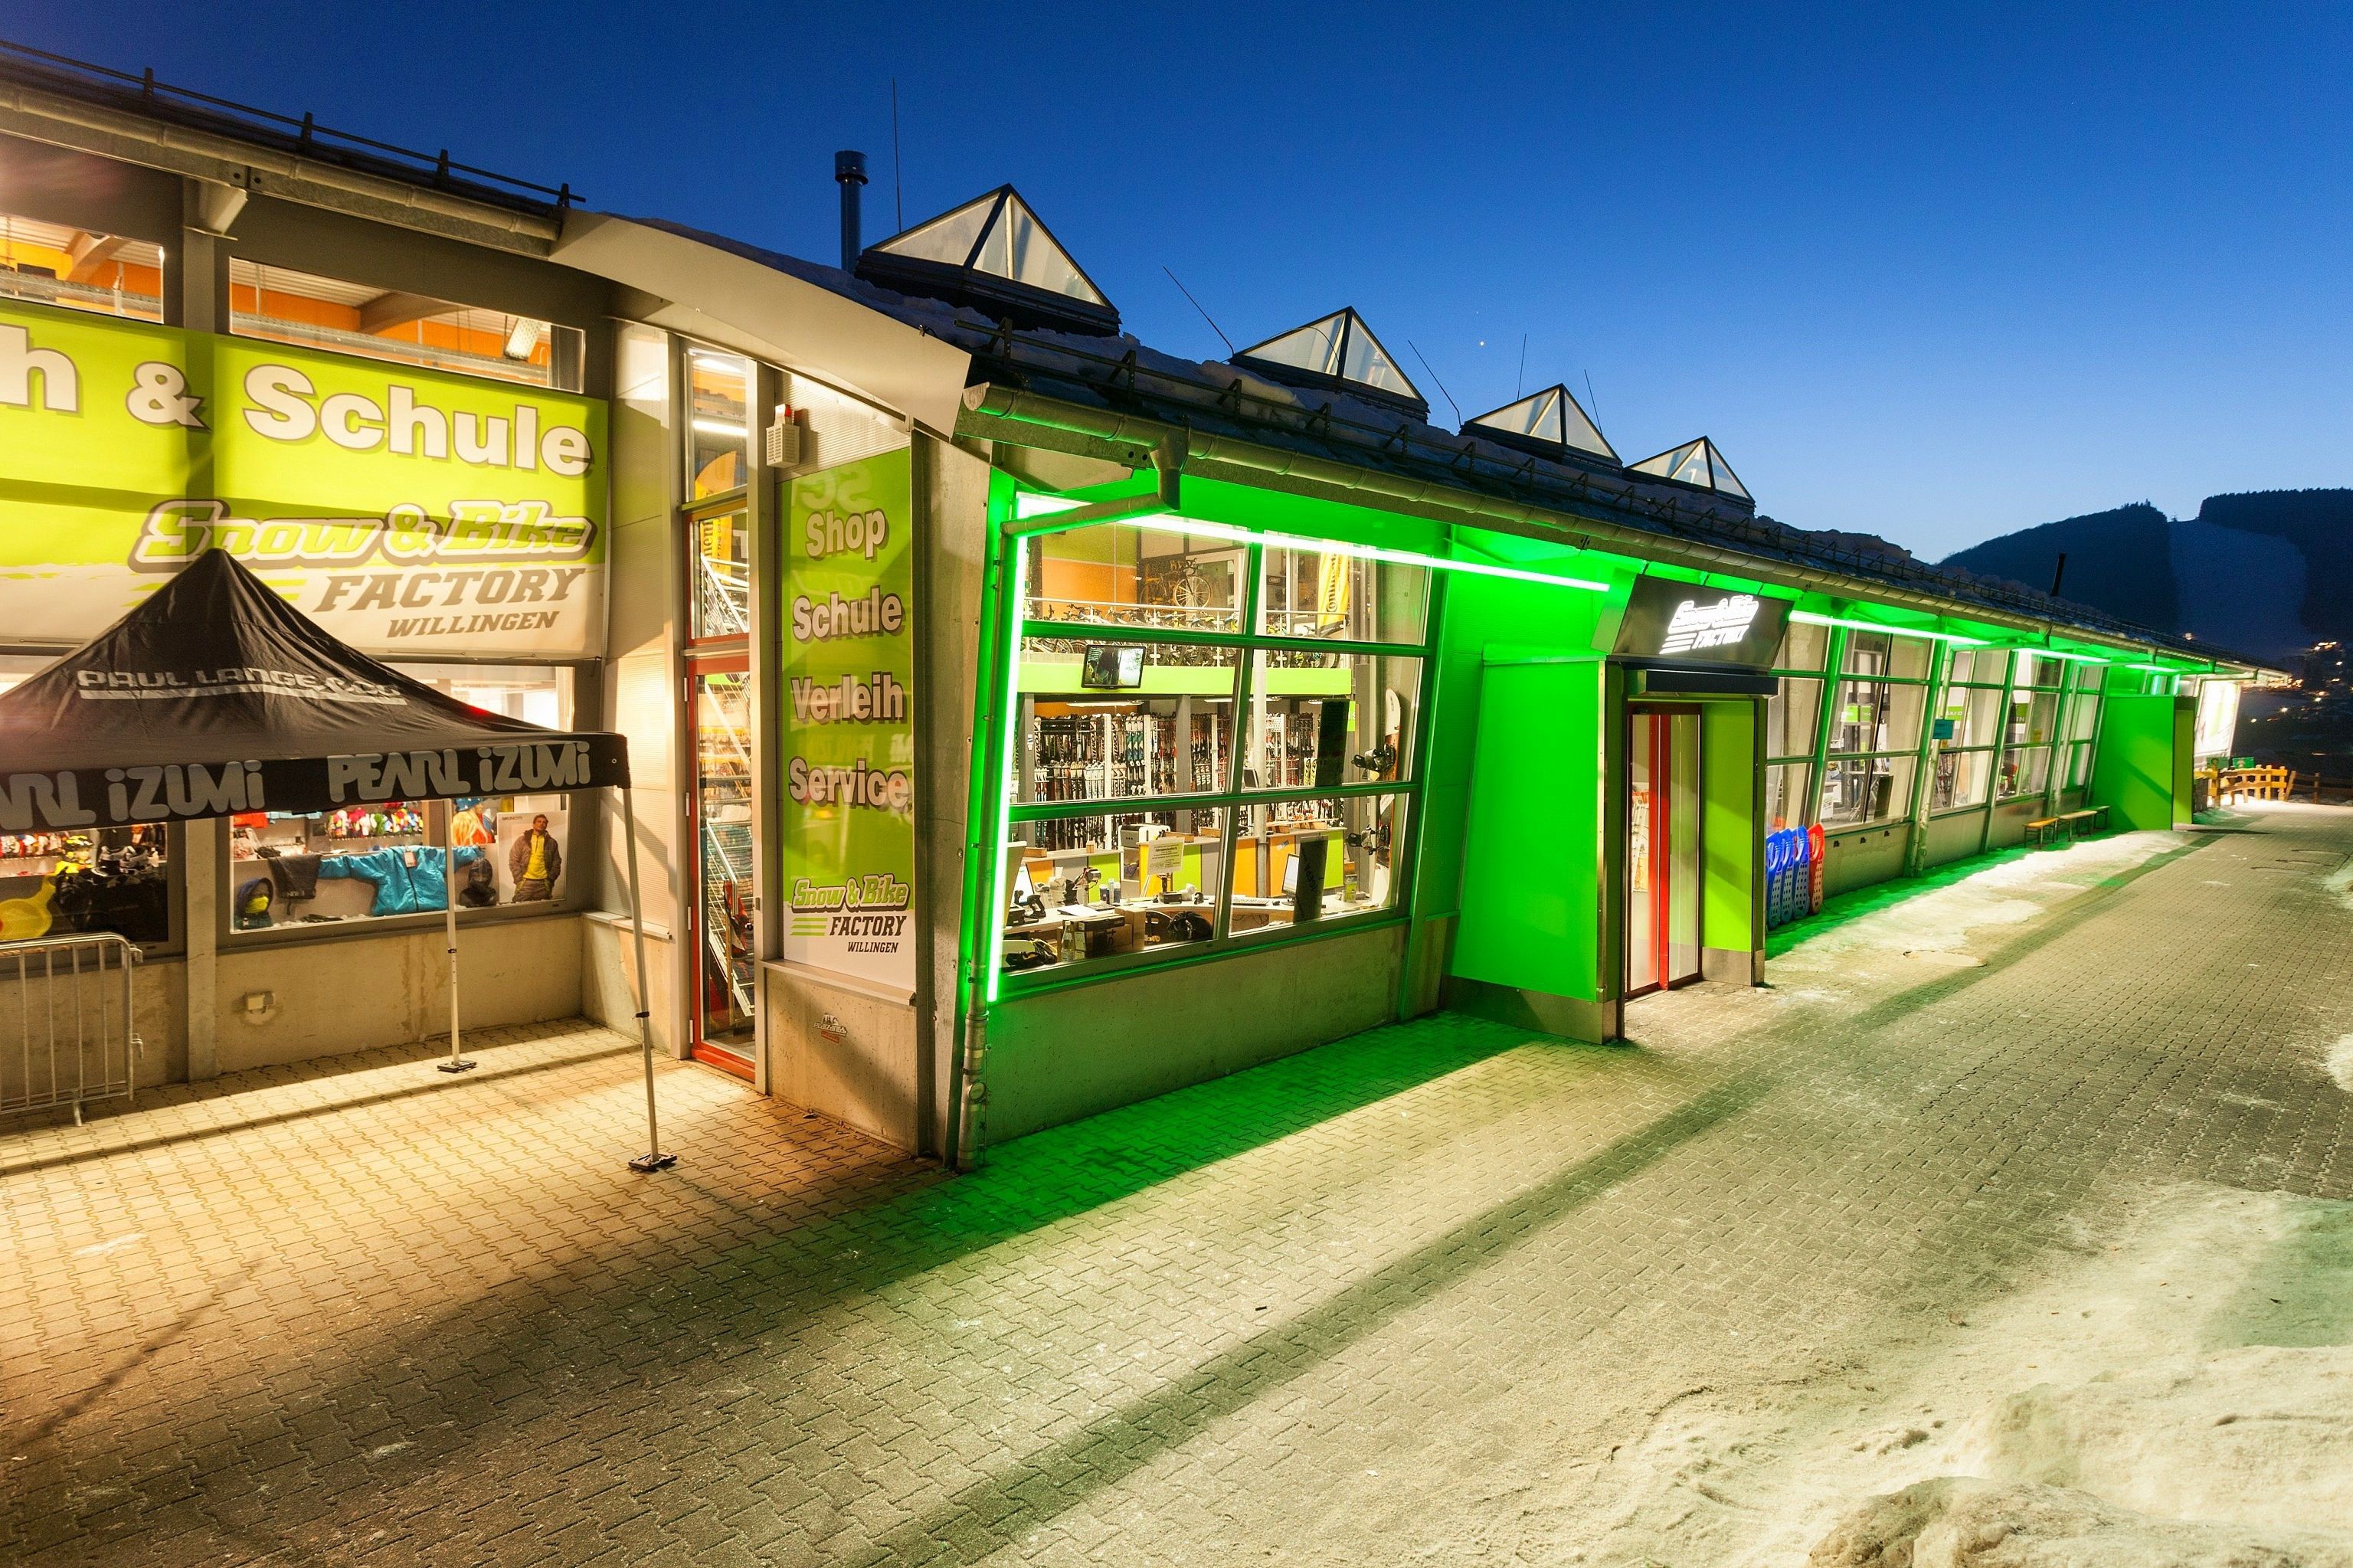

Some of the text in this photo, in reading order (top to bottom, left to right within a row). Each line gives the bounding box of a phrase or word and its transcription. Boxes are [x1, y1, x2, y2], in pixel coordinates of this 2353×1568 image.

[126, 361, 211, 434] &
[243, 364, 594, 477] Schule
[130, 499, 597, 571] Snow & Bike
[806, 508, 888, 562] Shop
[317, 568, 586, 612] FACTORY
[792, 584, 904, 642] Schule
[387, 611, 560, 638] WILLINGEN
[77, 669, 188, 688] PAUL
[196, 667, 322, 689] LANGE
[790, 672, 907, 722] Verleih
[327, 748, 471, 804] PEARL
[789, 756, 910, 810] Service
[792, 873, 910, 913] Snow & Bike
[830, 915, 908, 937] FACTORY
[847, 941, 899, 954] WILLINGEN
